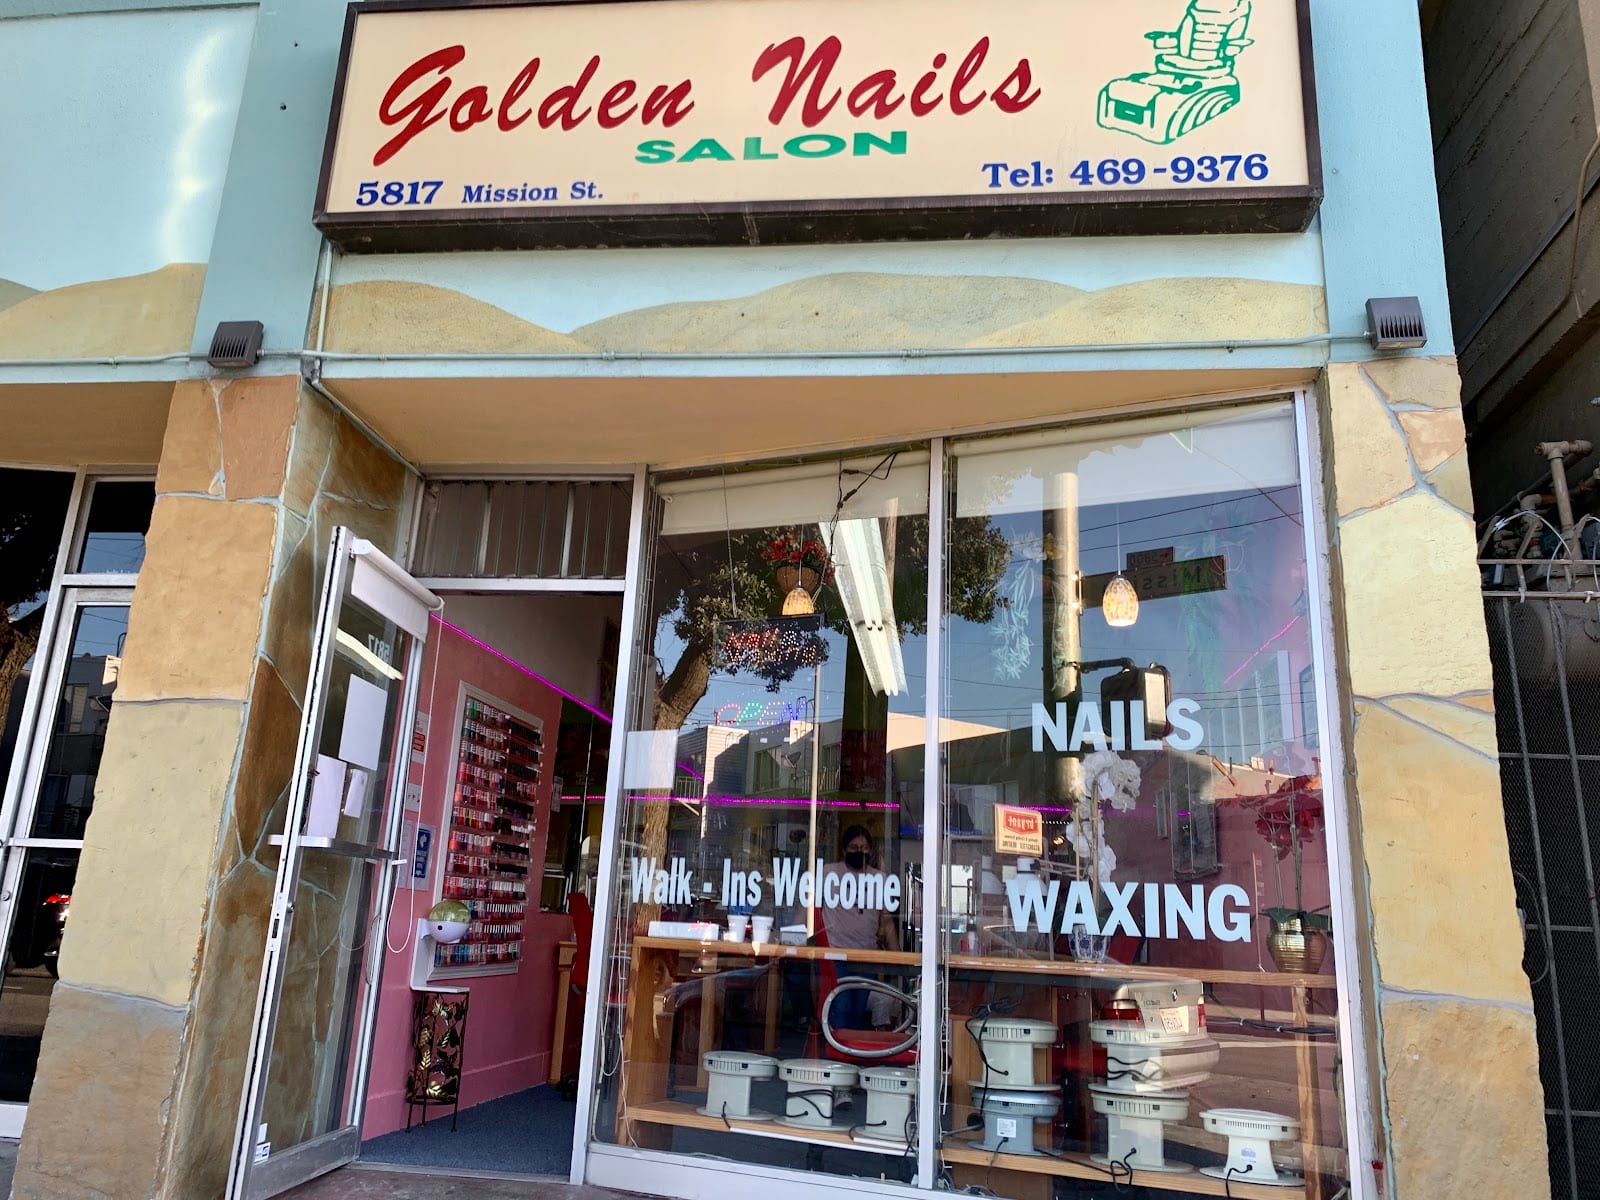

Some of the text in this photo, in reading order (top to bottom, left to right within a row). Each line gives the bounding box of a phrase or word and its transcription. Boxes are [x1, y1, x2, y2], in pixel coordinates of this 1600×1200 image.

[372, 35, 1041, 167] Golden Nails
[635, 131, 907, 165] SALON
[981, 154, 1269, 188] Tel: 469-9376
[355, 181, 604, 207] 5817 Mission St.
[717, 700, 806, 726] OPEN
[1031, 698, 1204, 752] NAILS
[632, 857, 692, 905] Walk
[722, 858, 762, 907] Ins
[773, 857, 900, 913] Welcome
[1006, 879, 1252, 943] WAXING
